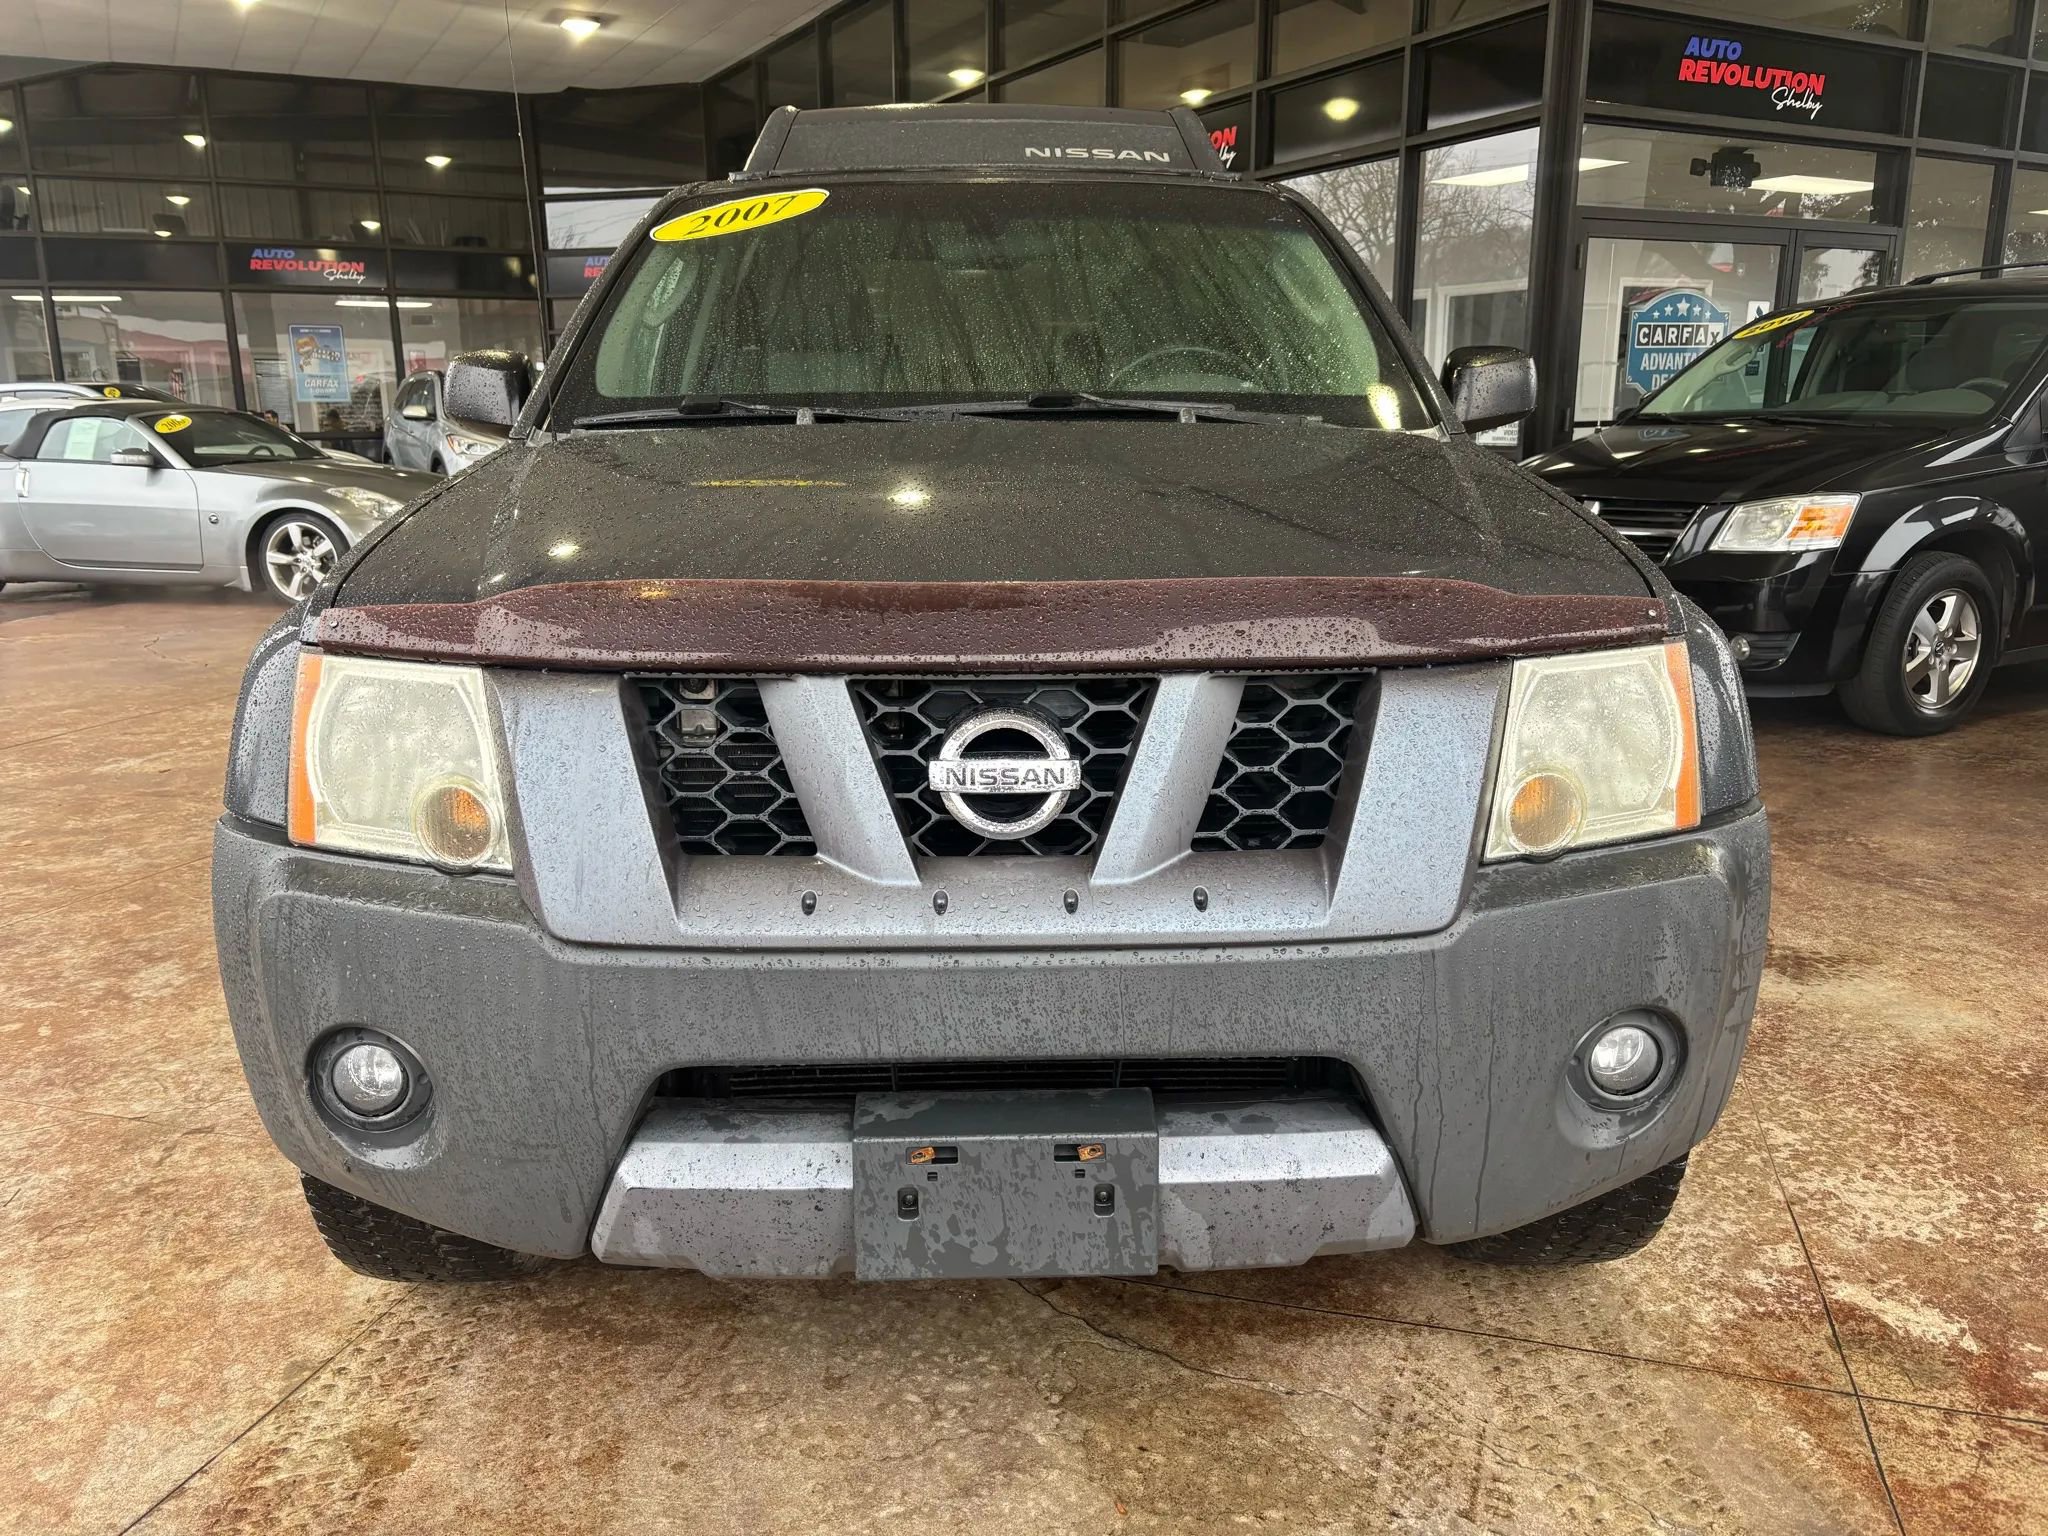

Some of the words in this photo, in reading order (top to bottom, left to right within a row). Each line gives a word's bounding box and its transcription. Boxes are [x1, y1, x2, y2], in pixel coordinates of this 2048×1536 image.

[1684, 36, 1743, 61] AUTO
[1678, 58, 1826, 96] REVOLUTION
[1771, 86, 1823, 120] Shelby
[1025, 147, 1171, 163] NISSAN
[684, 195, 798, 236] 2007
[251, 248, 295, 259] AUTO
[584, 256, 609, 266] AUT
[249, 258, 365, 273] REVOLUTION
[323, 269, 366, 284] Shelby
[1639, 325, 1720, 346] CARFAX
[304, 379, 338, 388] CARFAX
[945, 767, 1065, 787] NISSAN
